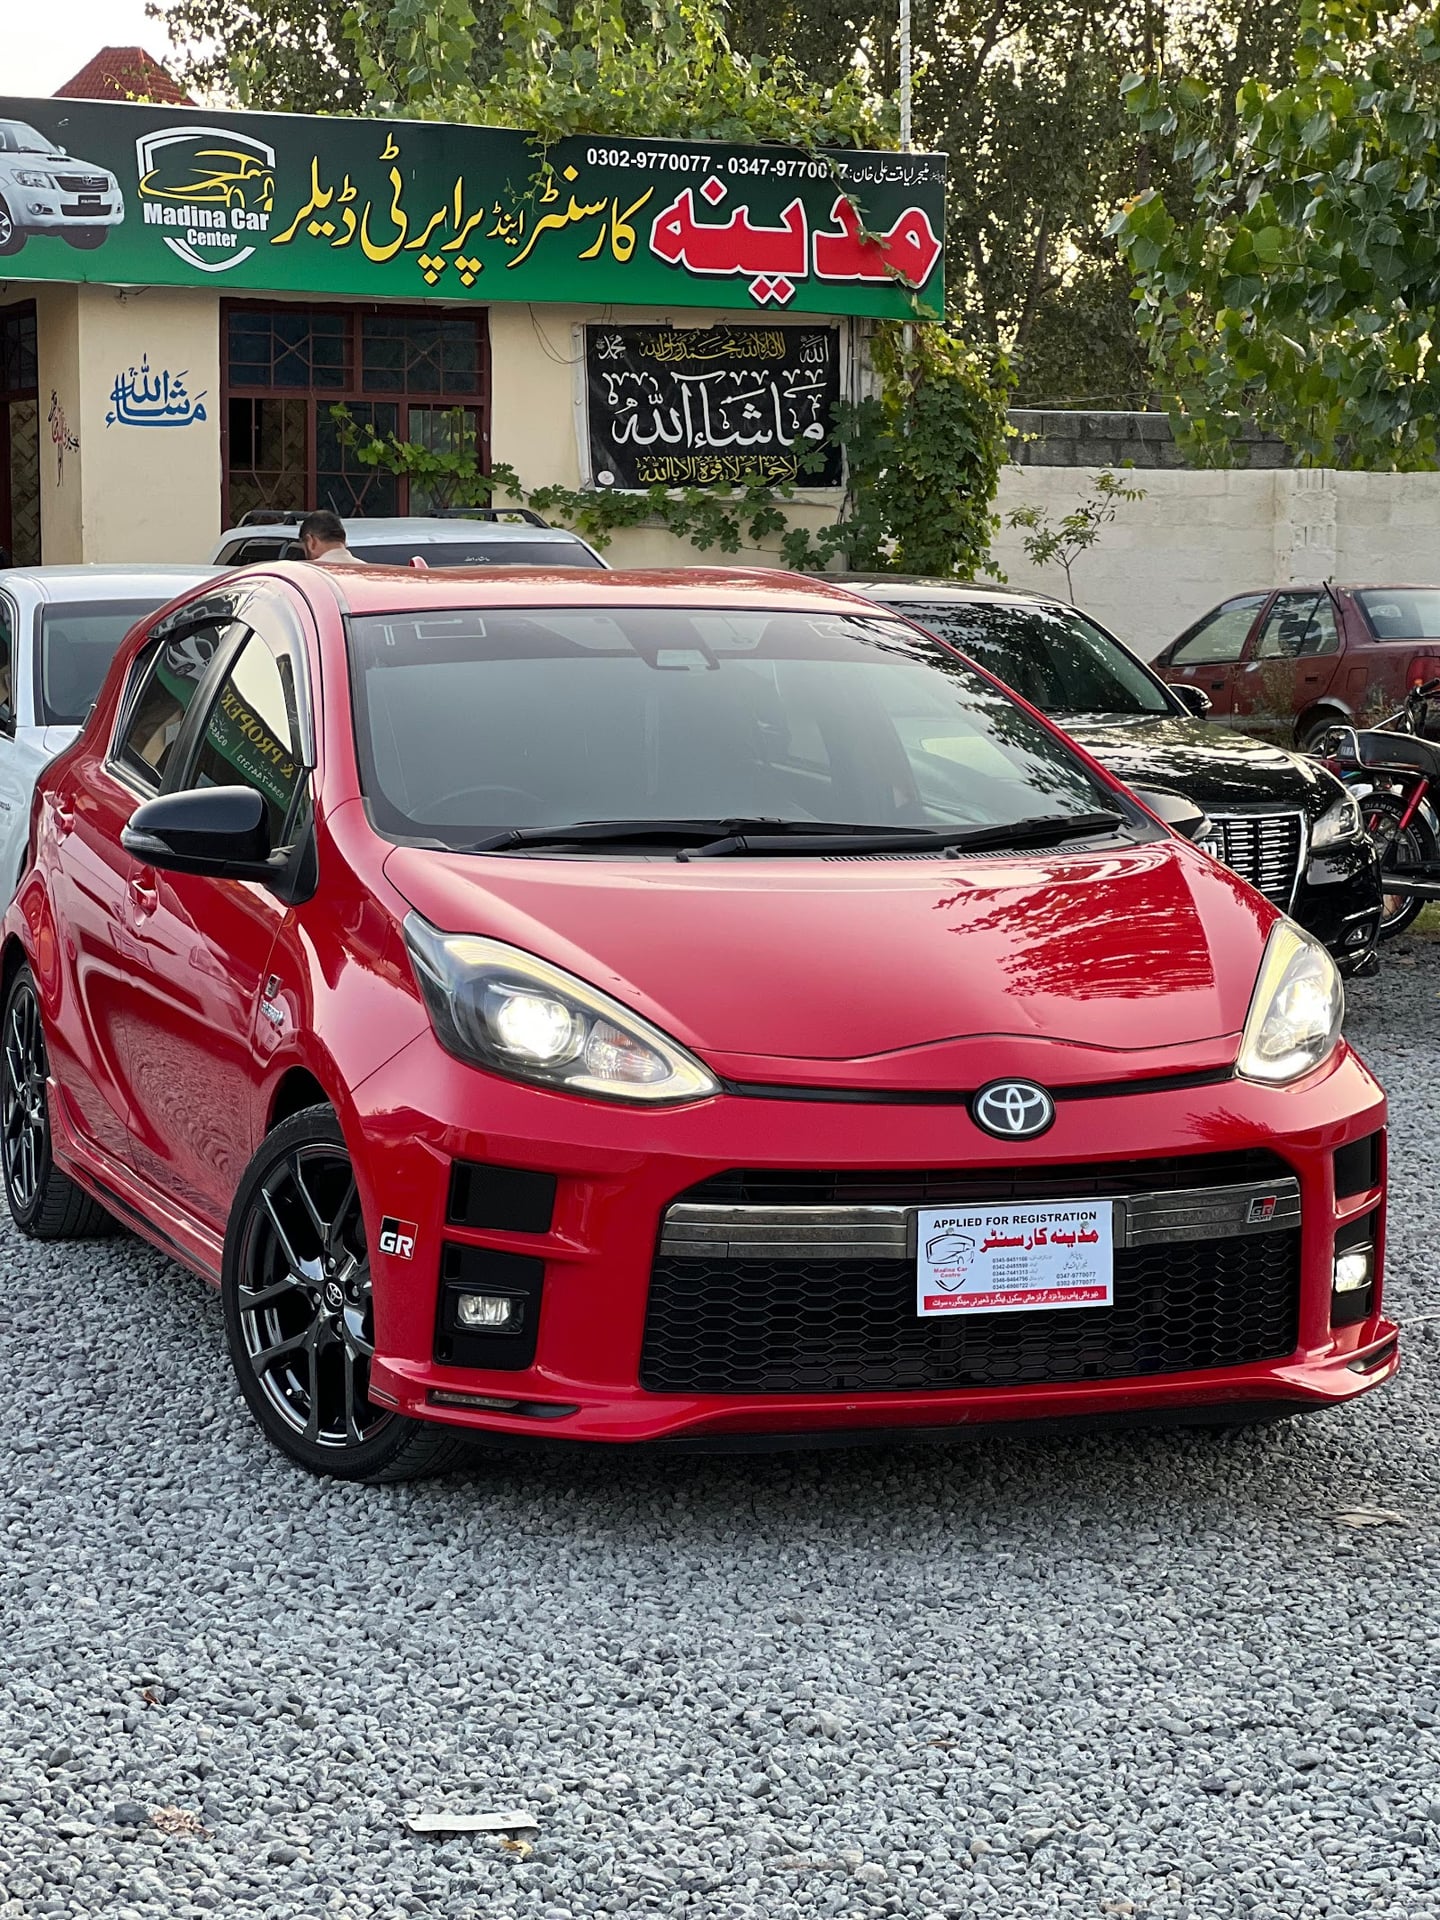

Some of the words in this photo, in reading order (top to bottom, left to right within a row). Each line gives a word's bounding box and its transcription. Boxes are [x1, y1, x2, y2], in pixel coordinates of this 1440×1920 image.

[586, 148, 711, 173] 0302-9770077
[885, 165, 914, 187] لیاقت
[270, 155, 358, 247] ڈیلر
[143, 202, 227, 228] Madina
[230, 207, 270, 231] Car
[186, 228, 238, 247] Center
[649, 174, 943, 304] مدینہ
[933, 1217, 982, 1229] APPLIED
[986, 1216, 1009, 1226] FOR
[1012, 1211, 1097, 1225] REGISTRATION
[1251, 1204, 1273, 1216] GR
[380, 1231, 414, 1257] GR
[1050, 1227, 1099, 1248] مدینہ
